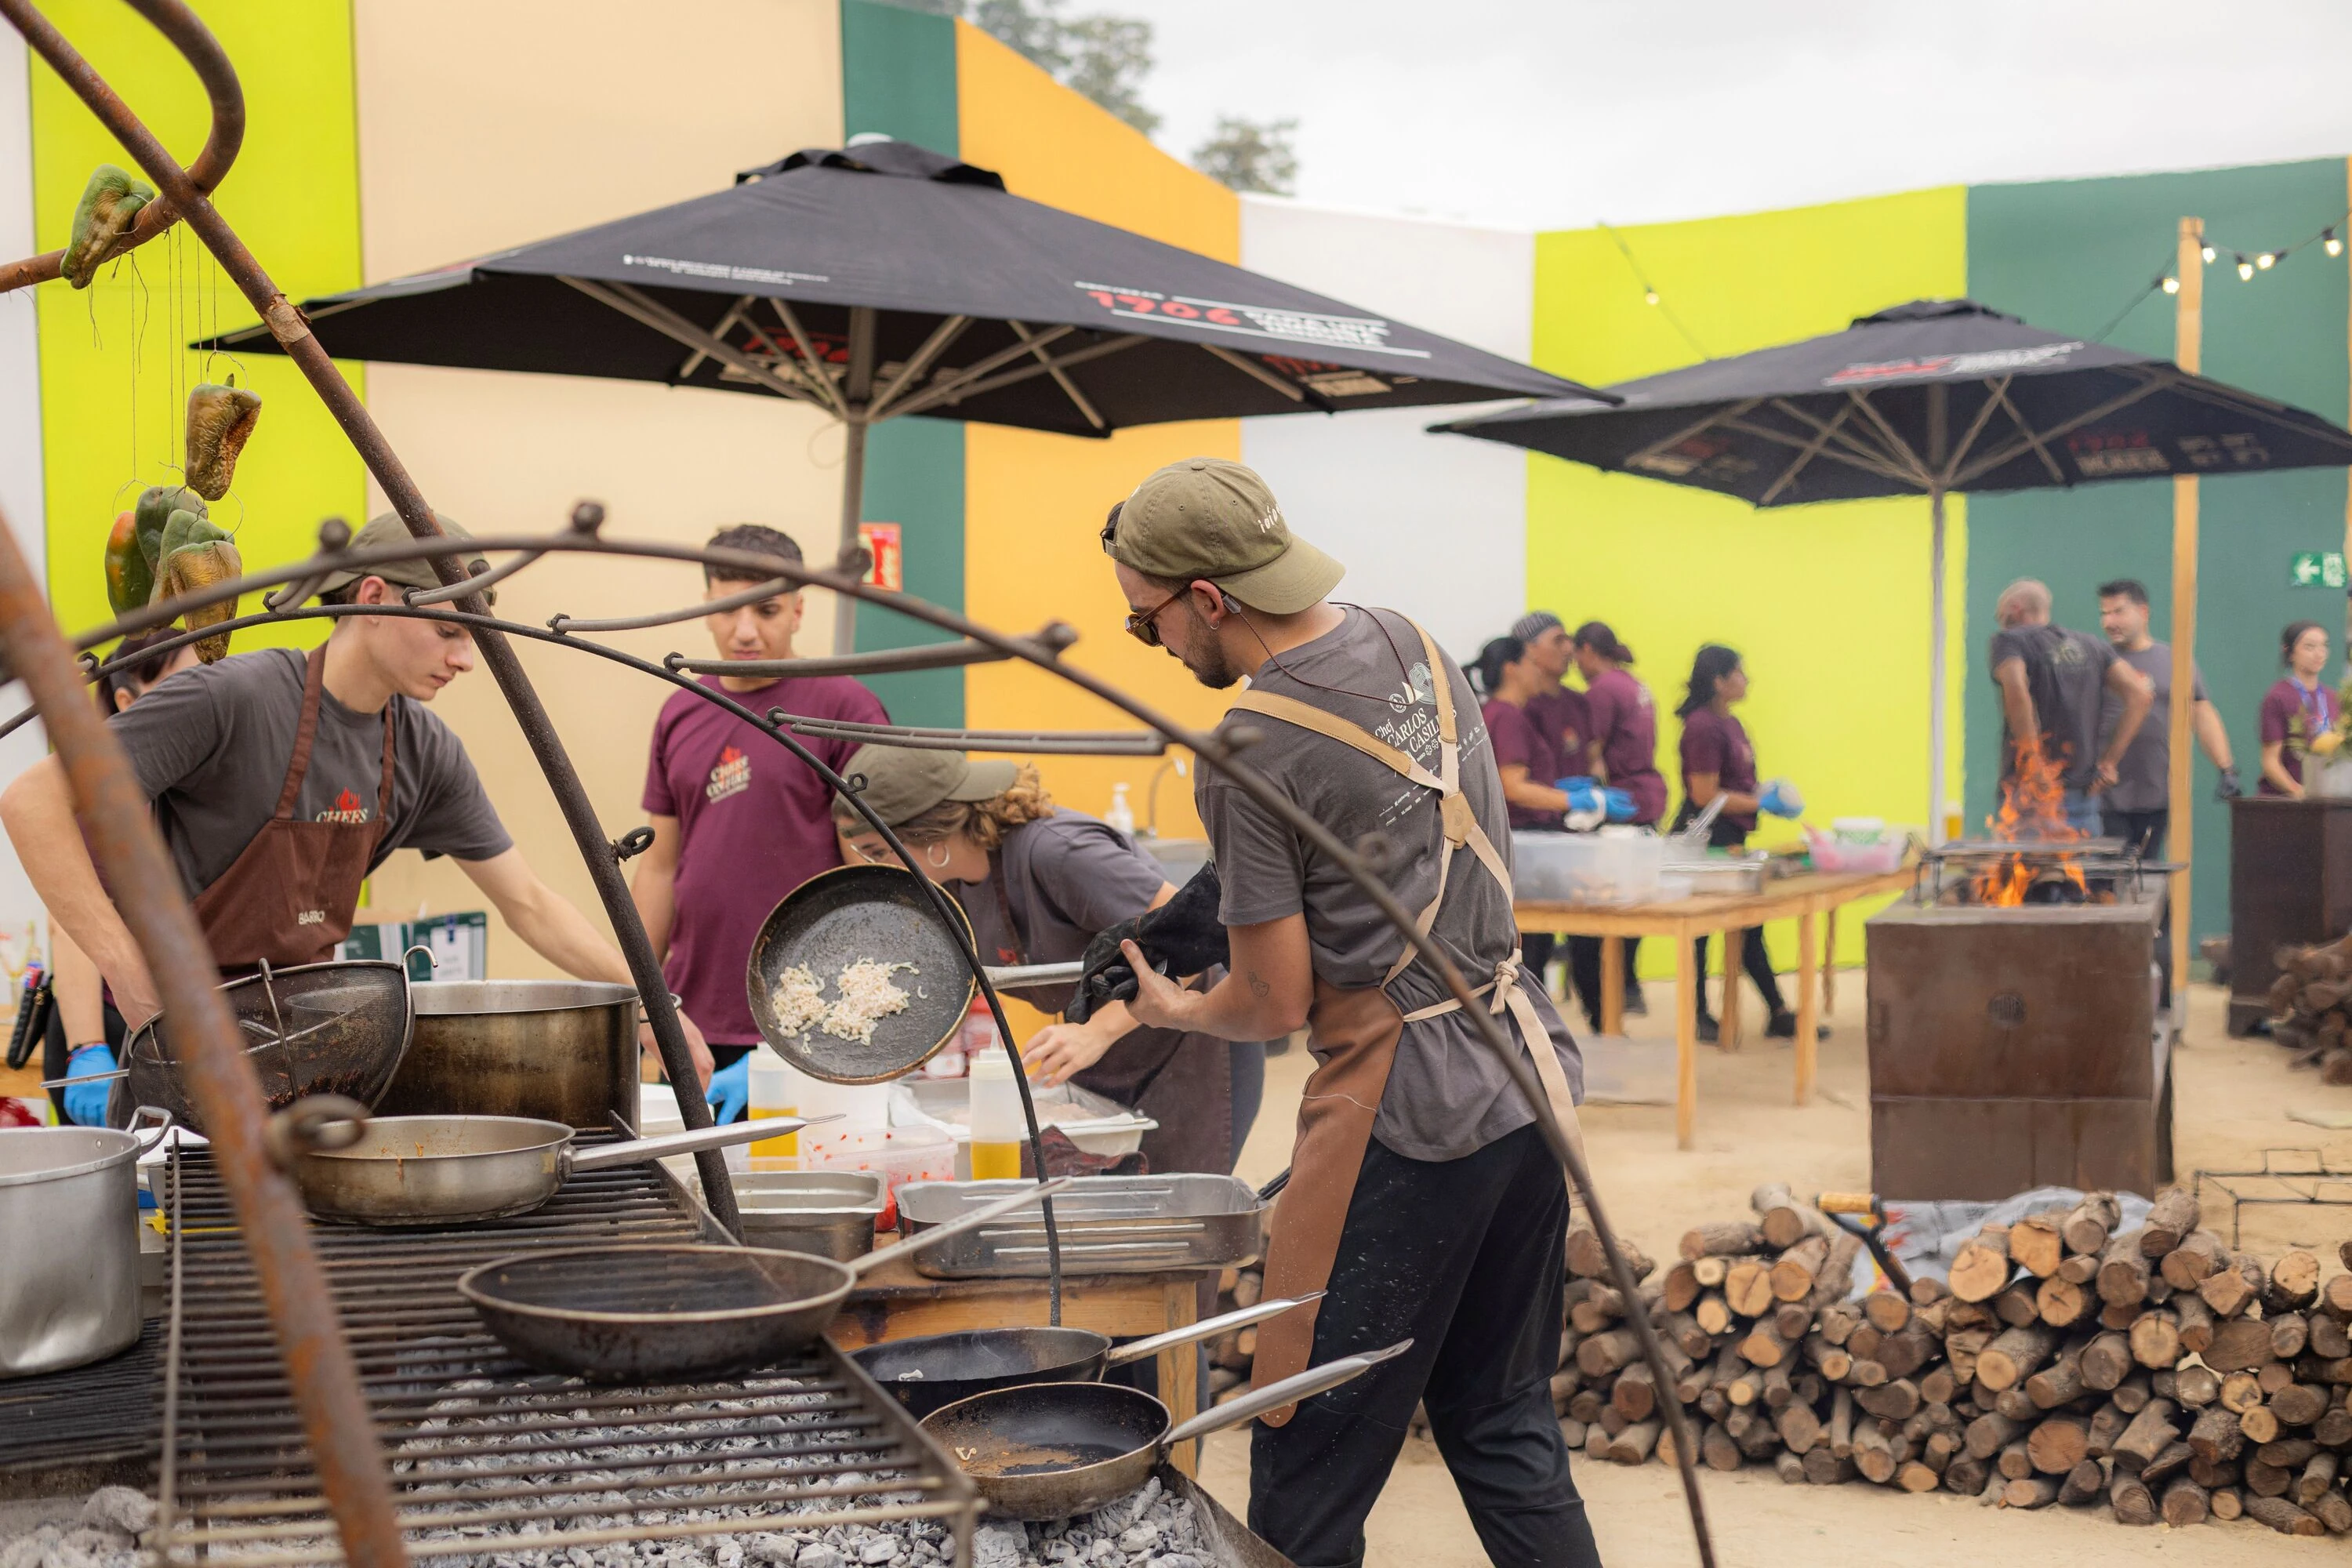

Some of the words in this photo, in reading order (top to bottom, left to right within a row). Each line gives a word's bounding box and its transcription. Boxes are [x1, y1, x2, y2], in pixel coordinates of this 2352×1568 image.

[1087, 289, 1241, 326] 1906
[1374, 717, 1395, 739] Chef
[1387, 707, 1427, 748] CARLOS
[315, 808, 368, 824] CHEFS
[298, 909, 325, 925] BARRO
